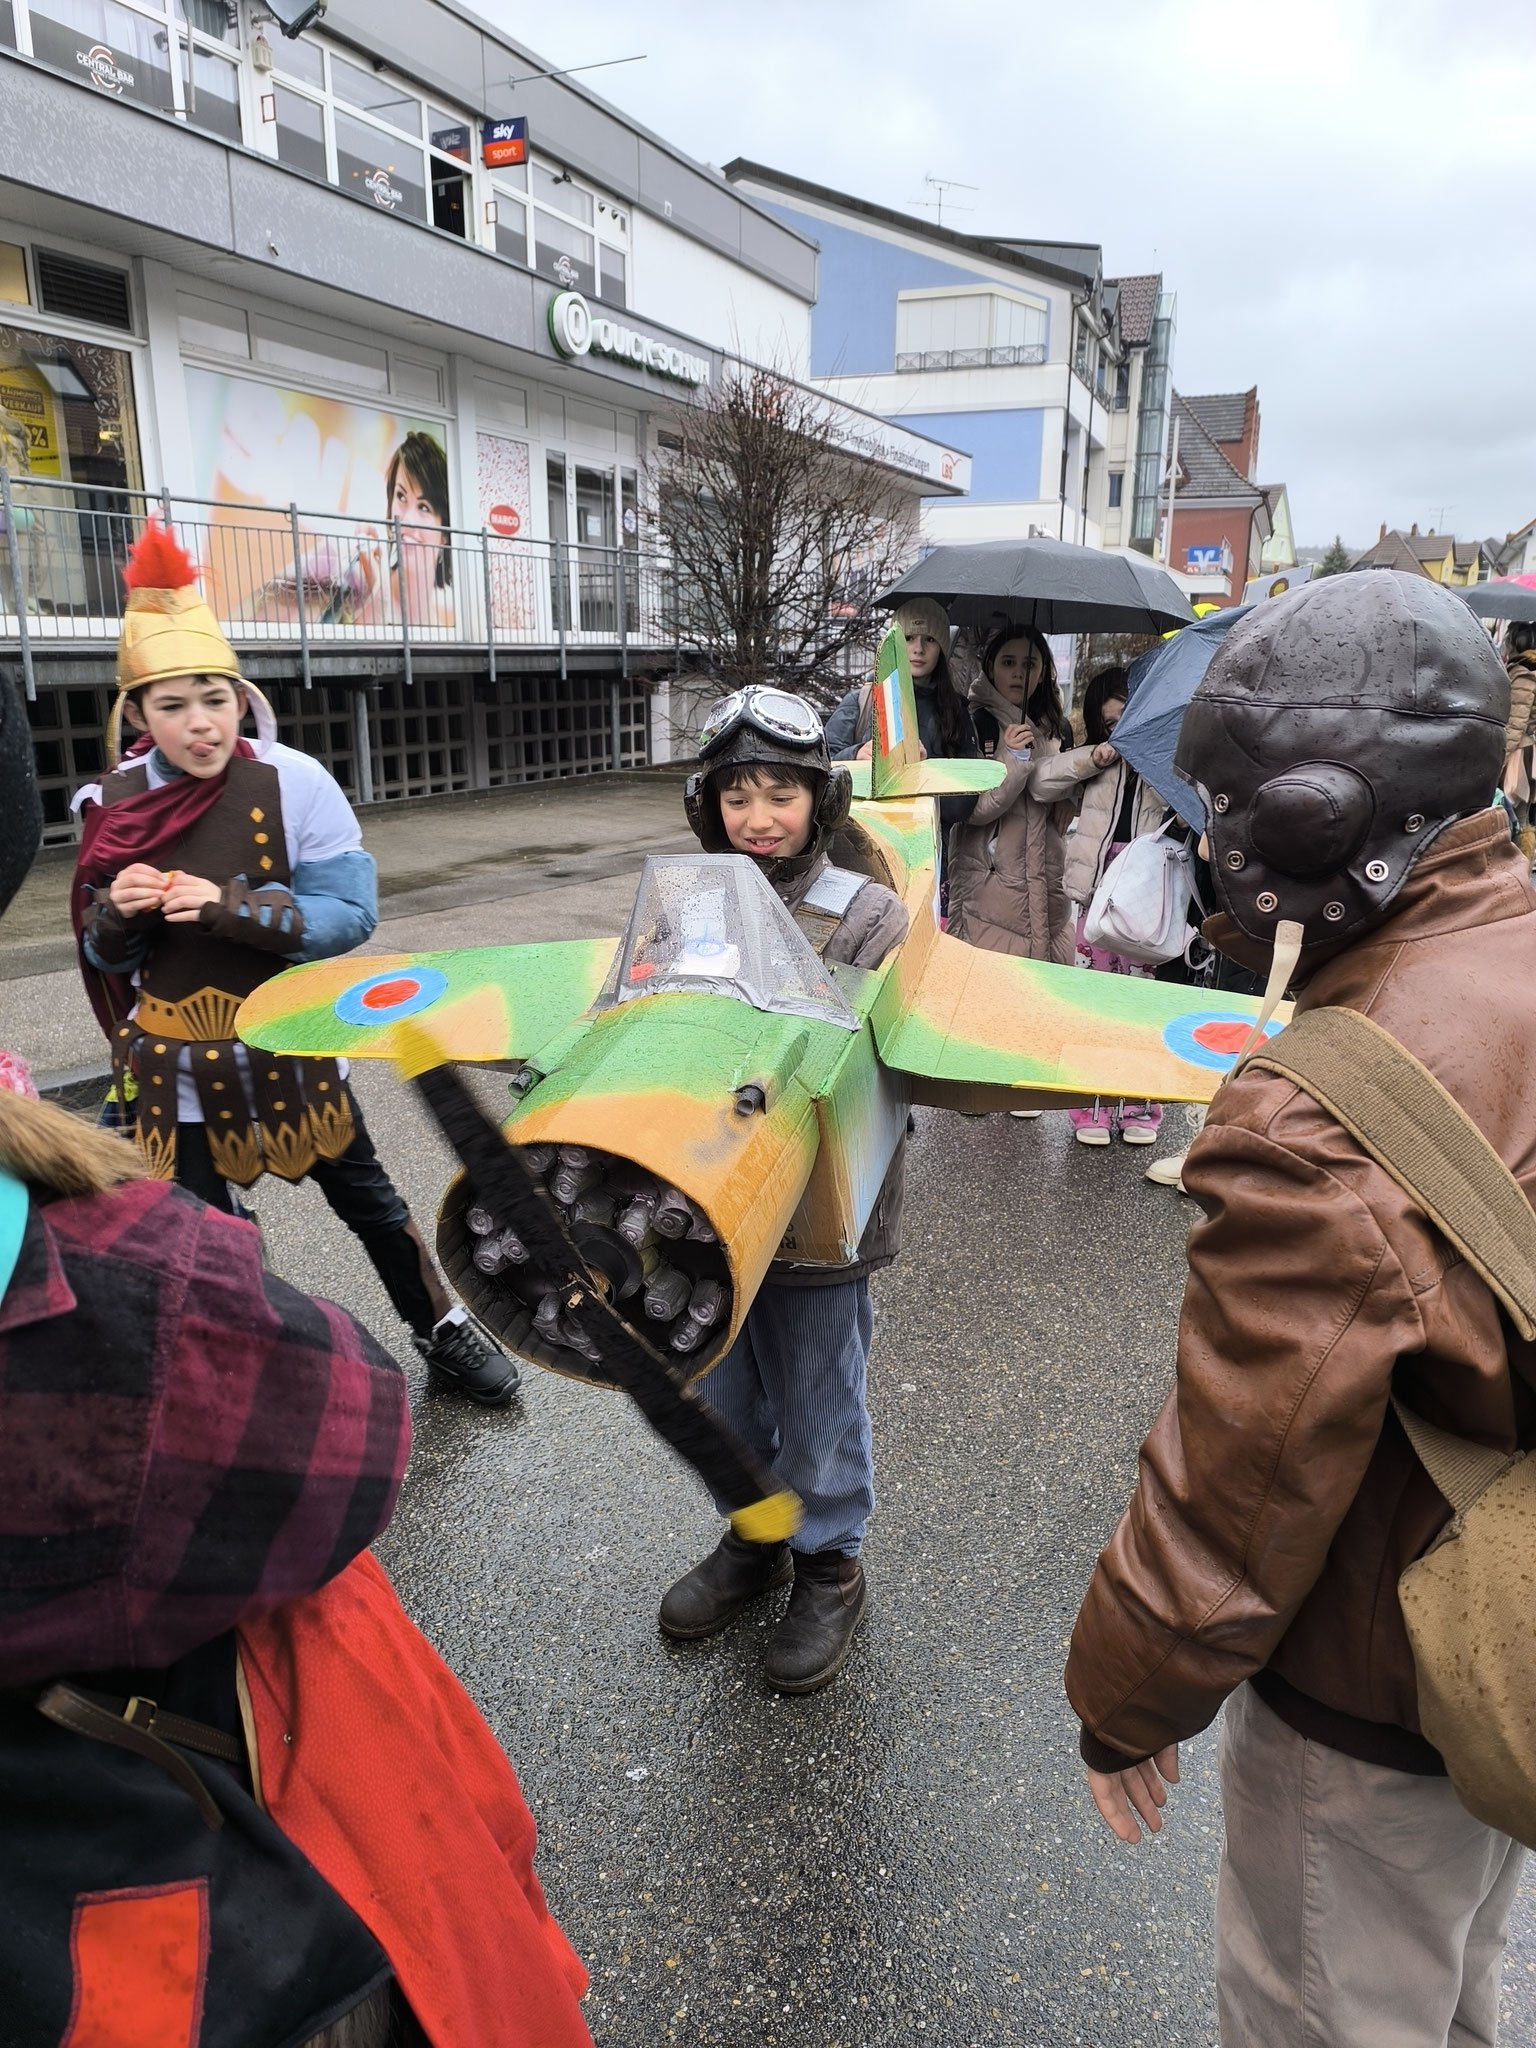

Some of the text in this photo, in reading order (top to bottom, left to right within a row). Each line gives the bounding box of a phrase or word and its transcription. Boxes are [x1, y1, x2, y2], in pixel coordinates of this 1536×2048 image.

[76, 52, 117, 79] CENTRAL
[117, 69, 135, 87] BAR
[492, 123, 515, 141] sky
[491, 146, 517, 160] sport
[595, 318, 711, 384] QUICK SCHUH
[941, 461, 954, 480] LBS
[490, 512, 519, 527] MARCO
